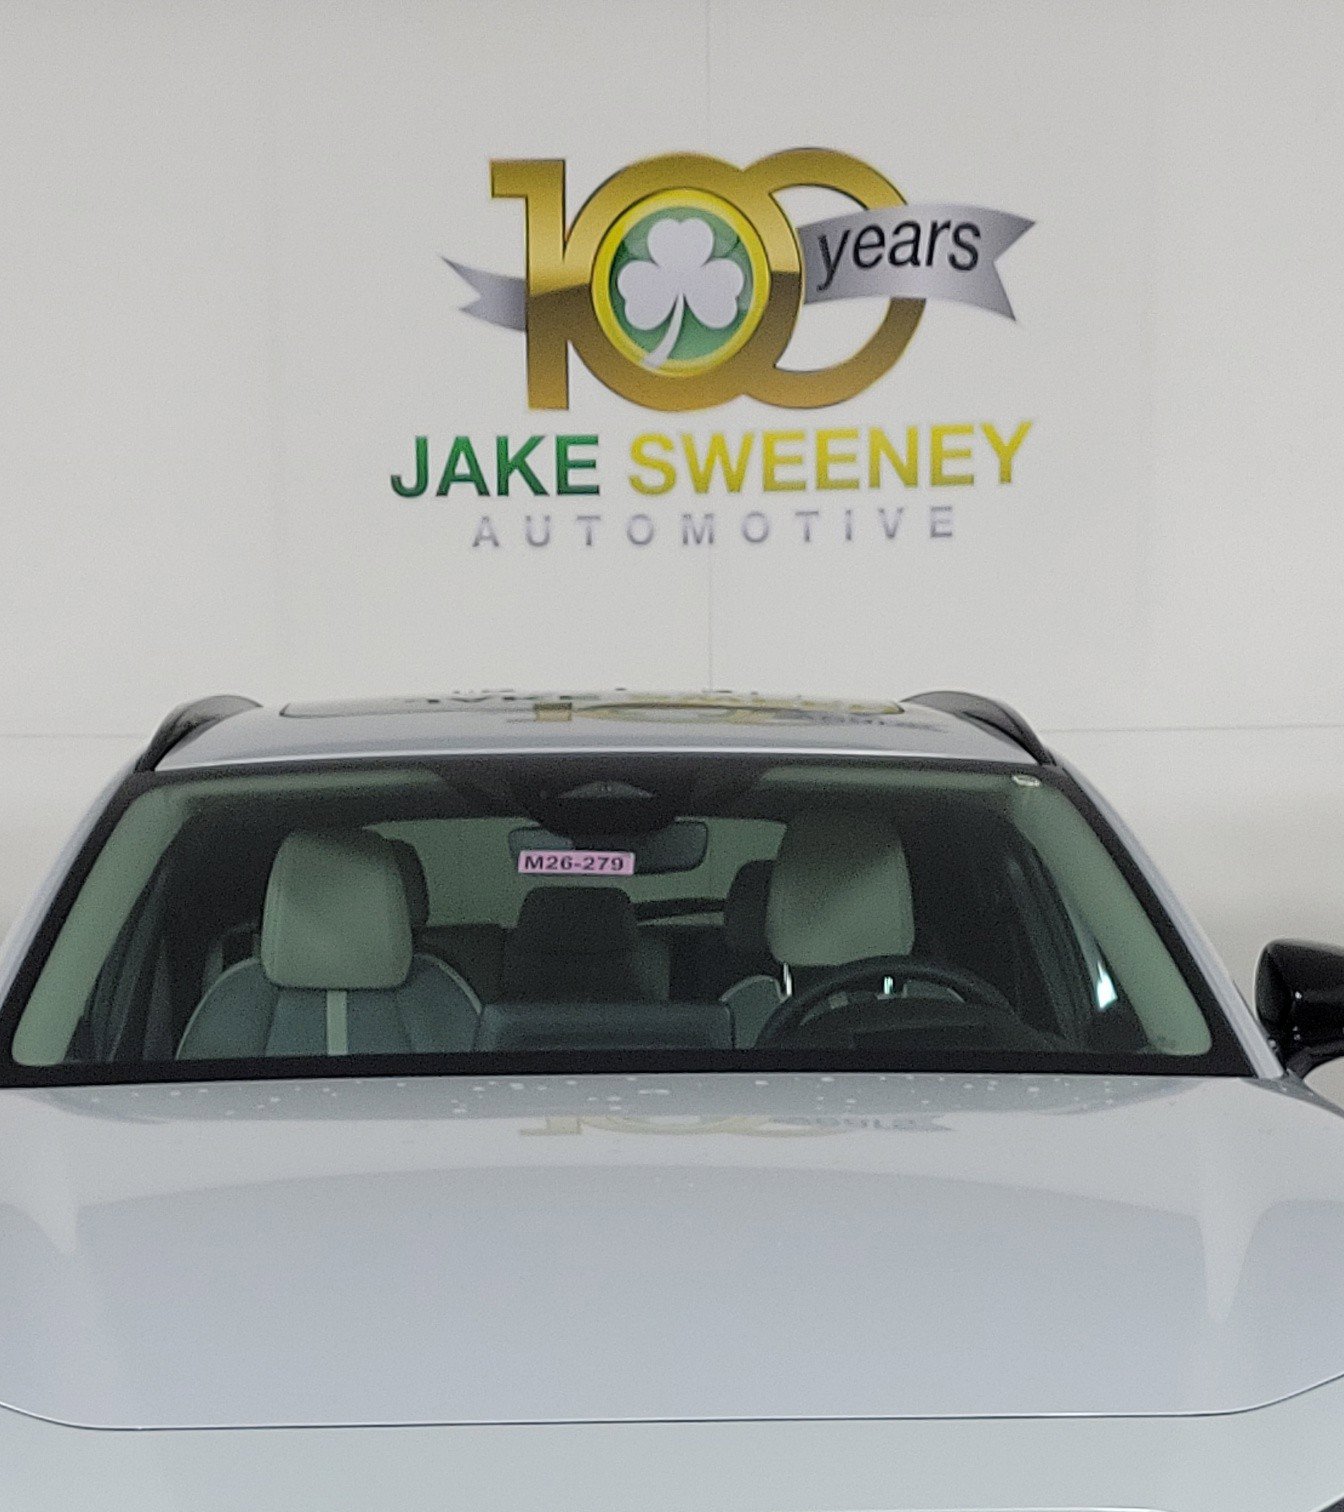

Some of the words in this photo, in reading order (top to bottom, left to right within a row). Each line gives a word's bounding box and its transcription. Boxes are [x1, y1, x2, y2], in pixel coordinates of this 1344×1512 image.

[489, 147, 926, 412] 100
[816, 218, 980, 293] years
[391, 435, 600, 497] JAKE
[629, 422, 1032, 496] SWEENEY
[472, 506, 953, 547] AUTOMOTIVE
[524, 855, 623, 871] M26-279
